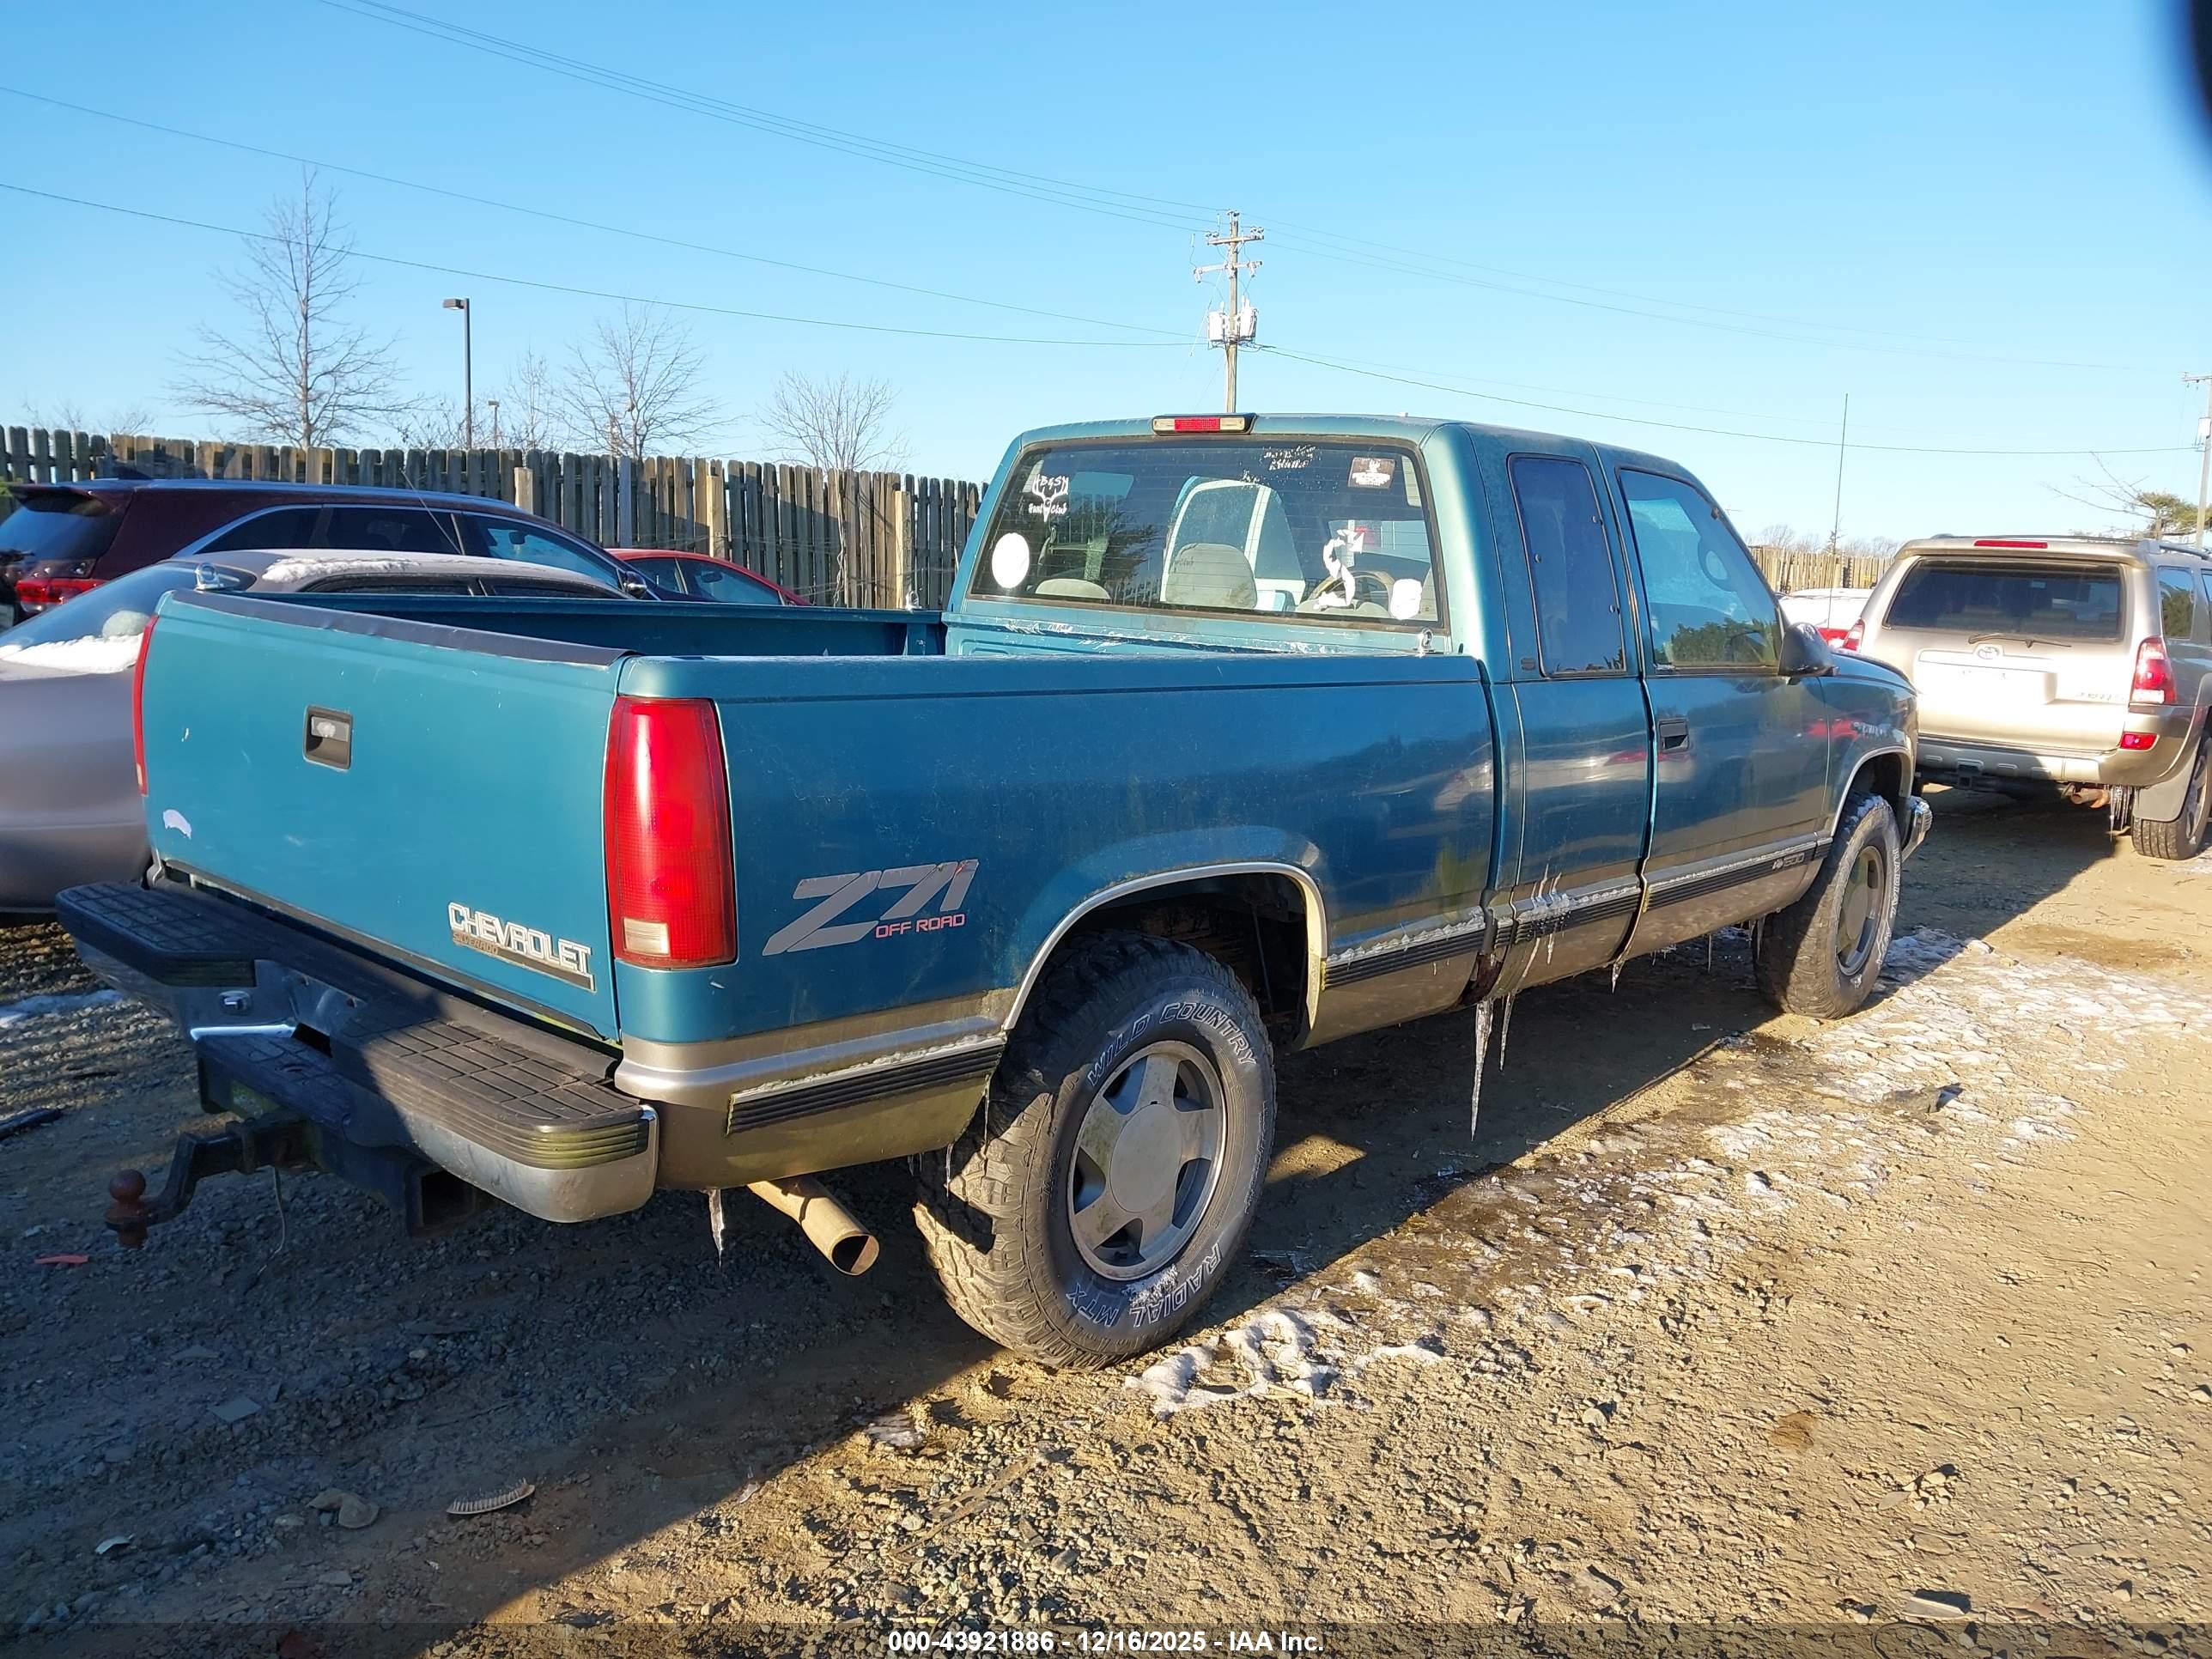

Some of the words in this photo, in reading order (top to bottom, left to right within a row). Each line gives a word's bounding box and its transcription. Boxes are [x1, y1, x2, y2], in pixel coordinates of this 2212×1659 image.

[448, 902, 592, 974] CHEVROLET
[763, 859, 979, 956] Z71
[876, 921, 912, 939] OFF
[916, 914, 965, 933] ROAD
[453, 933, 499, 955] SILVERADO
[1087, 1013, 1151, 1085] WILD
[1159, 1002, 1257, 1065] COUNTRY
[1066, 1282, 1119, 1328] MTX
[1129, 1243, 1222, 1328] RADIAL
